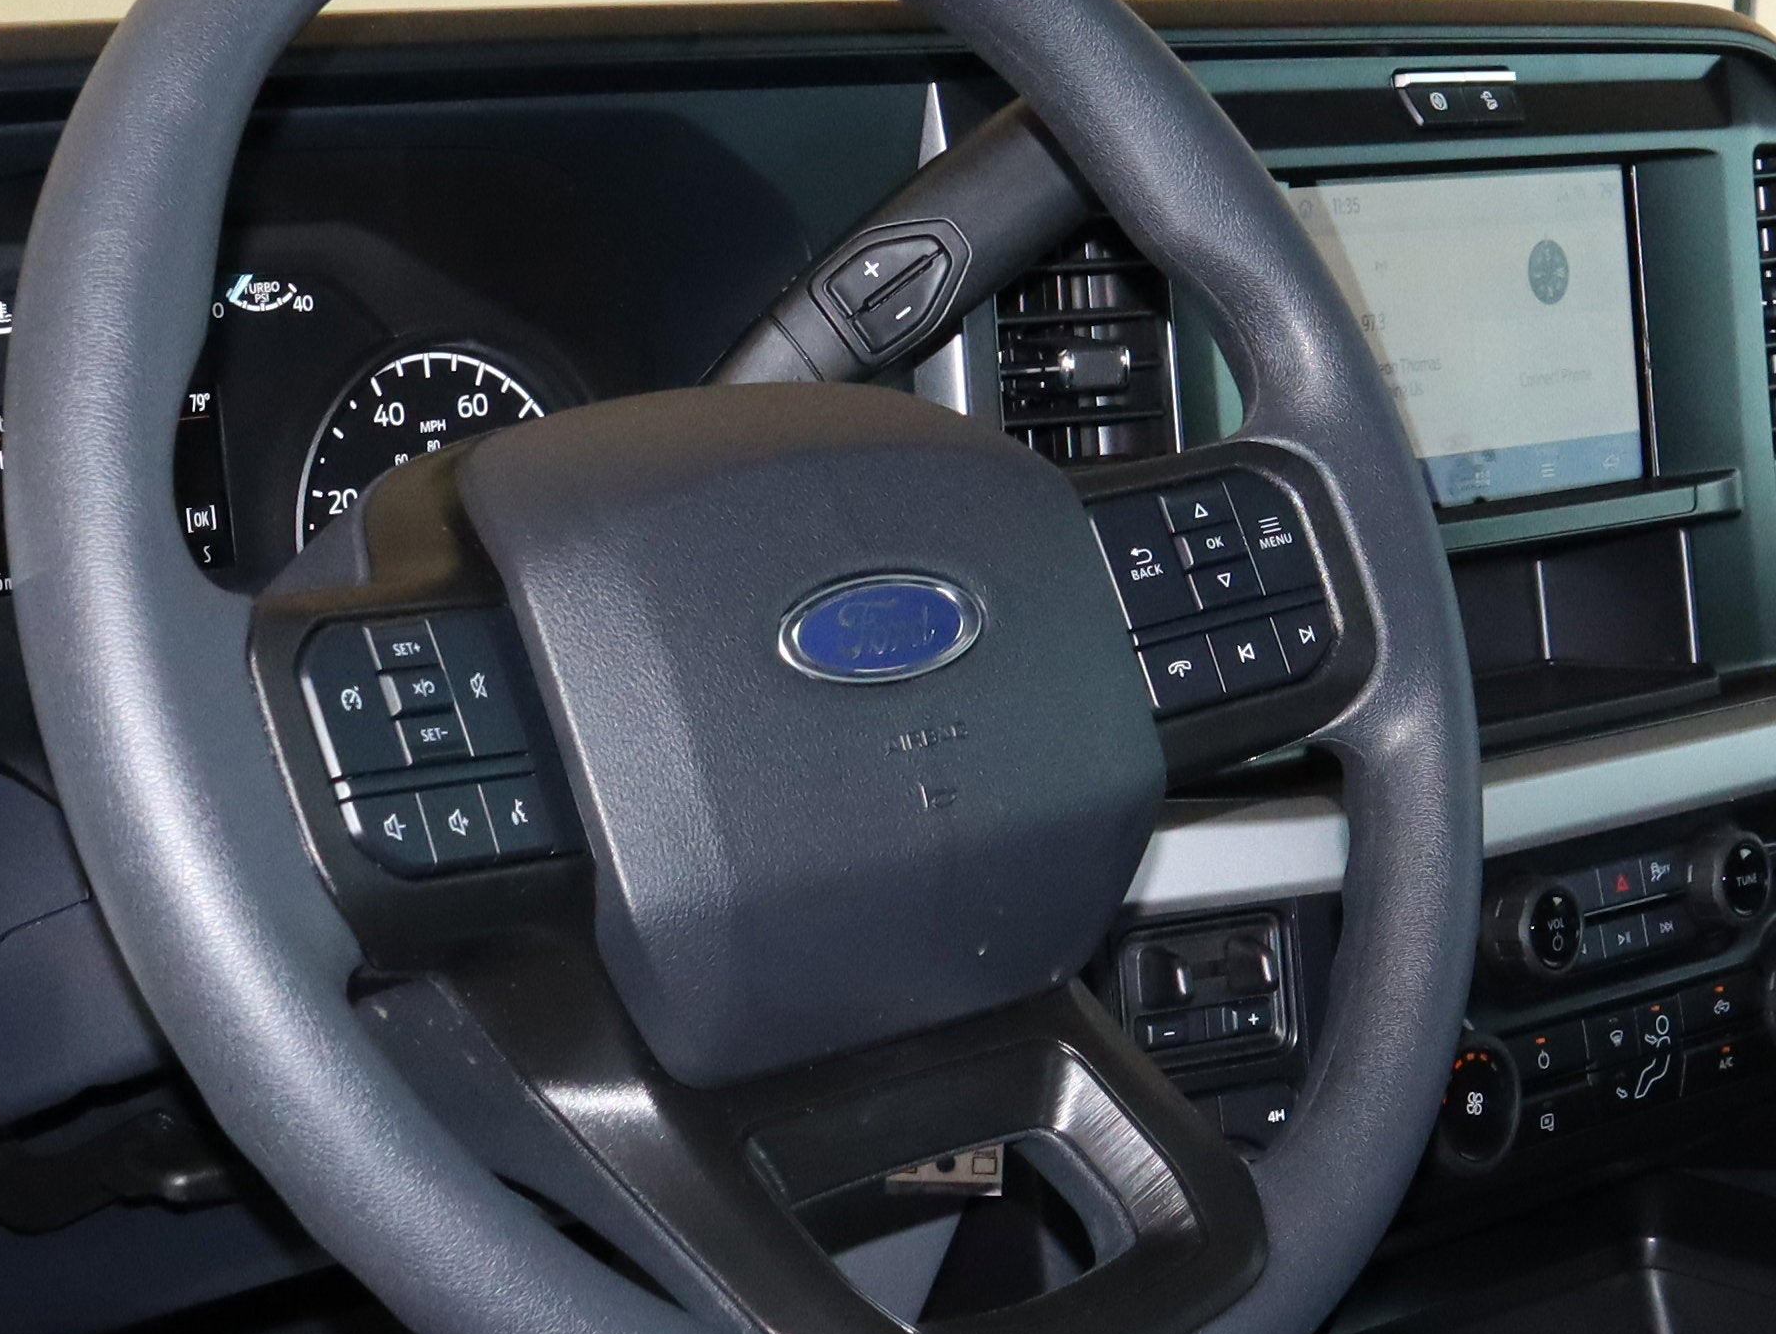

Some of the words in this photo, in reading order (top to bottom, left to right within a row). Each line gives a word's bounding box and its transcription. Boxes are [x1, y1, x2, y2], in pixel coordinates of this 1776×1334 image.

[254, 293, 269, 304] PSI
[293, 294, 314, 312] 40
[457, 393, 488, 418] 60
[374, 402, 405, 427] 40
[419, 419, 446, 434] MPH
[427, 439, 441, 453] 80
[1206, 536, 1224, 550] OK
[1259, 533, 1293, 550] MENU
[1131, 564, 1164, 581] BACK
[392, 643, 421, 657] SET+
[420, 728, 449, 742] SET-
[1735, 872, 1757, 887] TUNE
[1547, 919, 1565, 932] VOL
[1267, 1108, 1285, 1123] 4H
